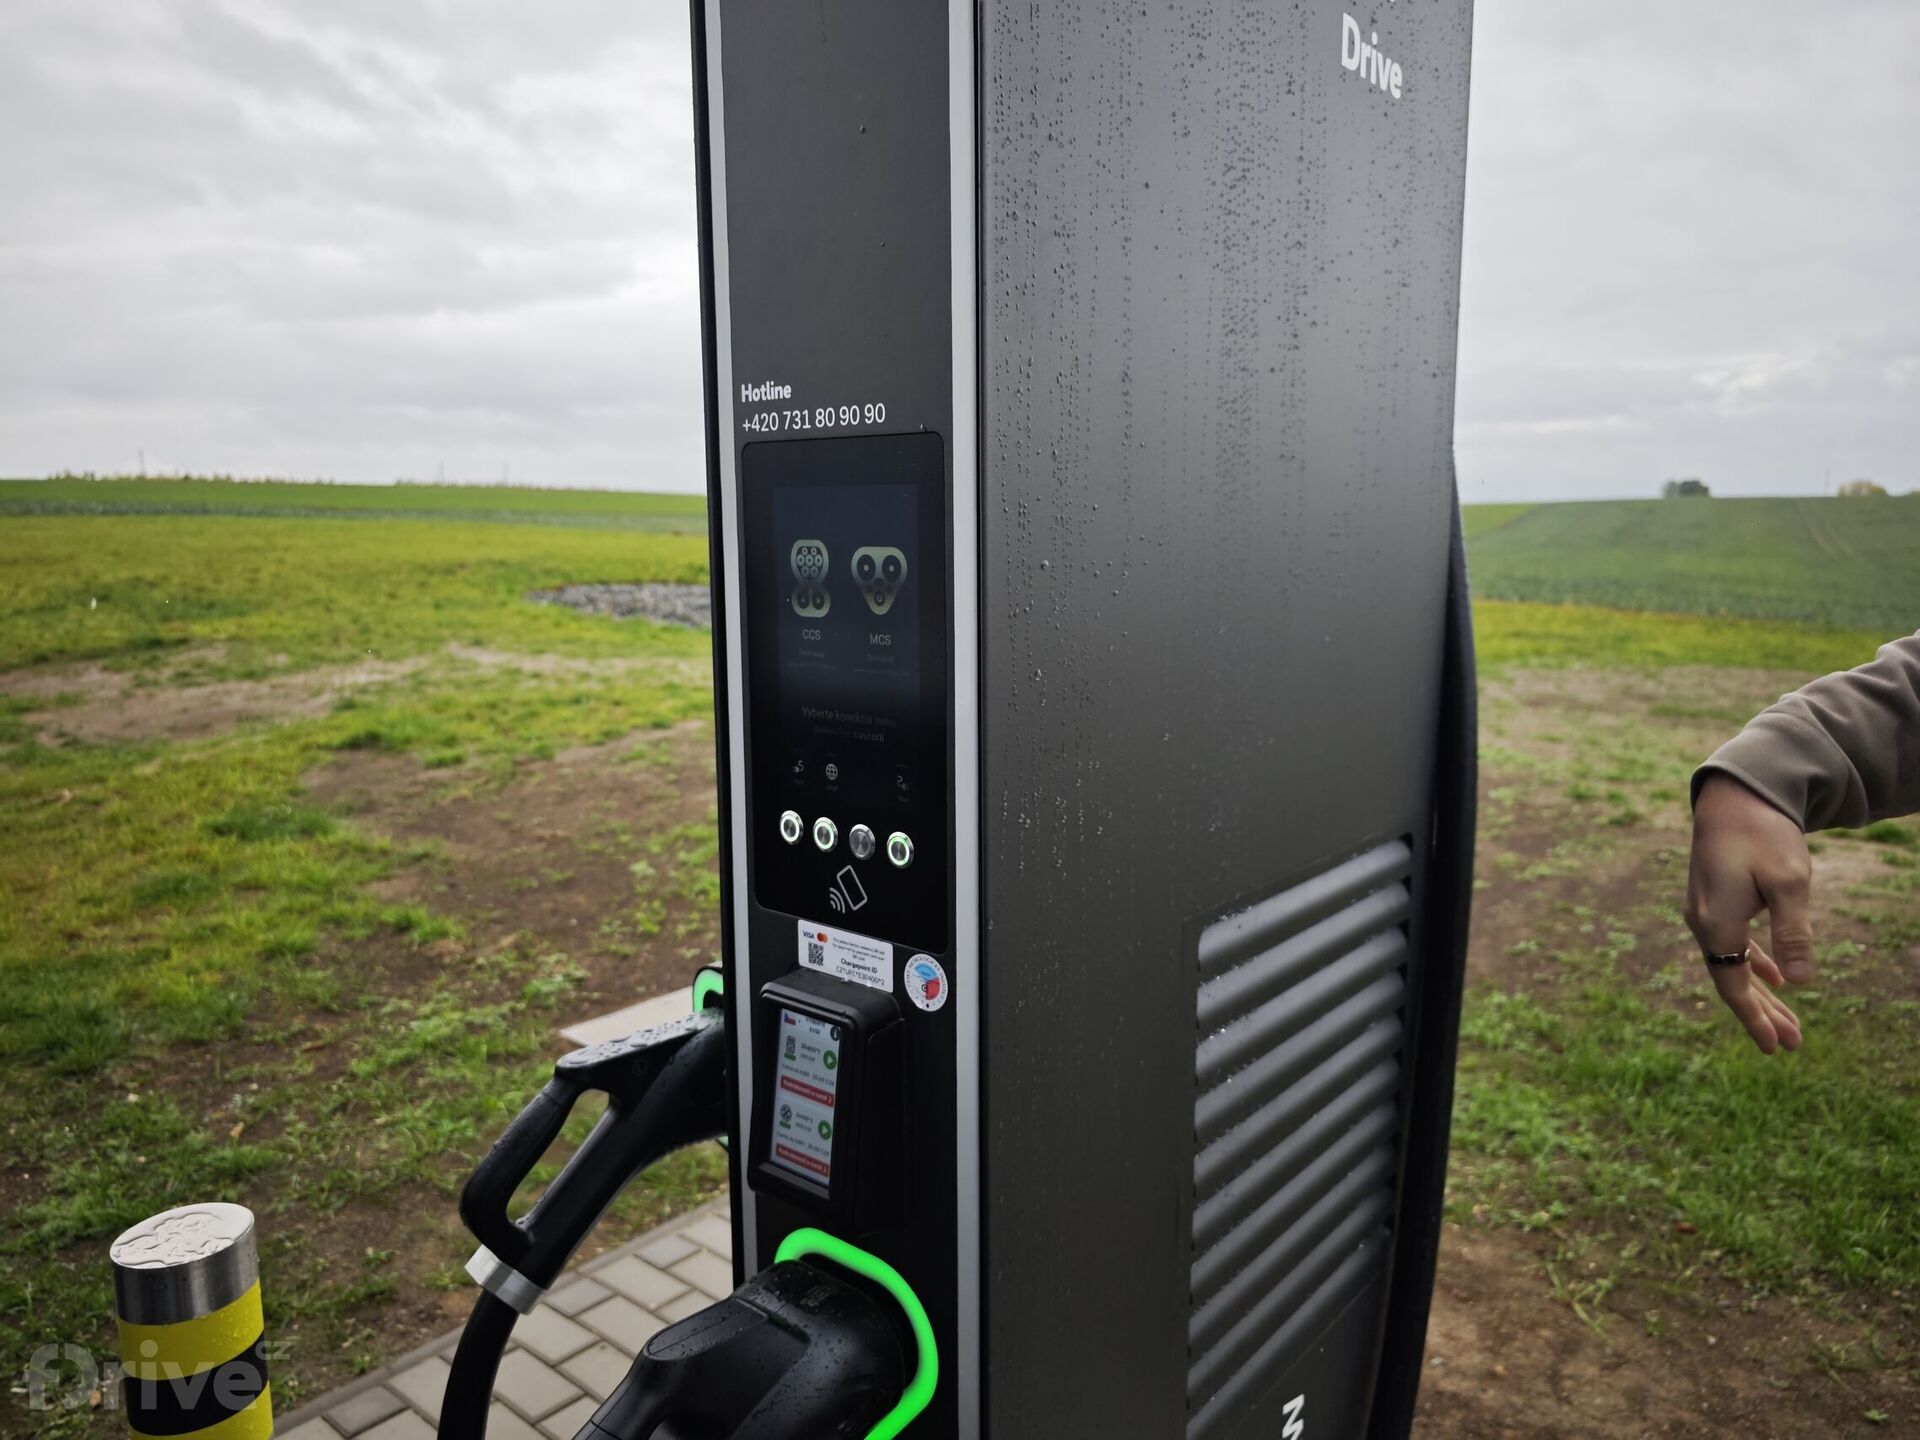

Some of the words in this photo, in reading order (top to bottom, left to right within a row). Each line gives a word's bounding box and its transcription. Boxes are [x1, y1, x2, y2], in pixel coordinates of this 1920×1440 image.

[1341, 12, 1403, 99] Drive
[741, 380, 792, 403] Hotline
[742, 412, 779, 432] +420
[782, 409, 811, 430] 731
[815, 407, 835, 428] 80
[839, 405, 860, 426] 90
[864, 402, 886, 424] 90
[802, 628, 821, 641] CCS
[869, 633, 892, 646] MCS
[802, 930, 815, 939] VISA
[840, 958, 871, 972] Chargepoint
[871, 966, 878, 974] ID
